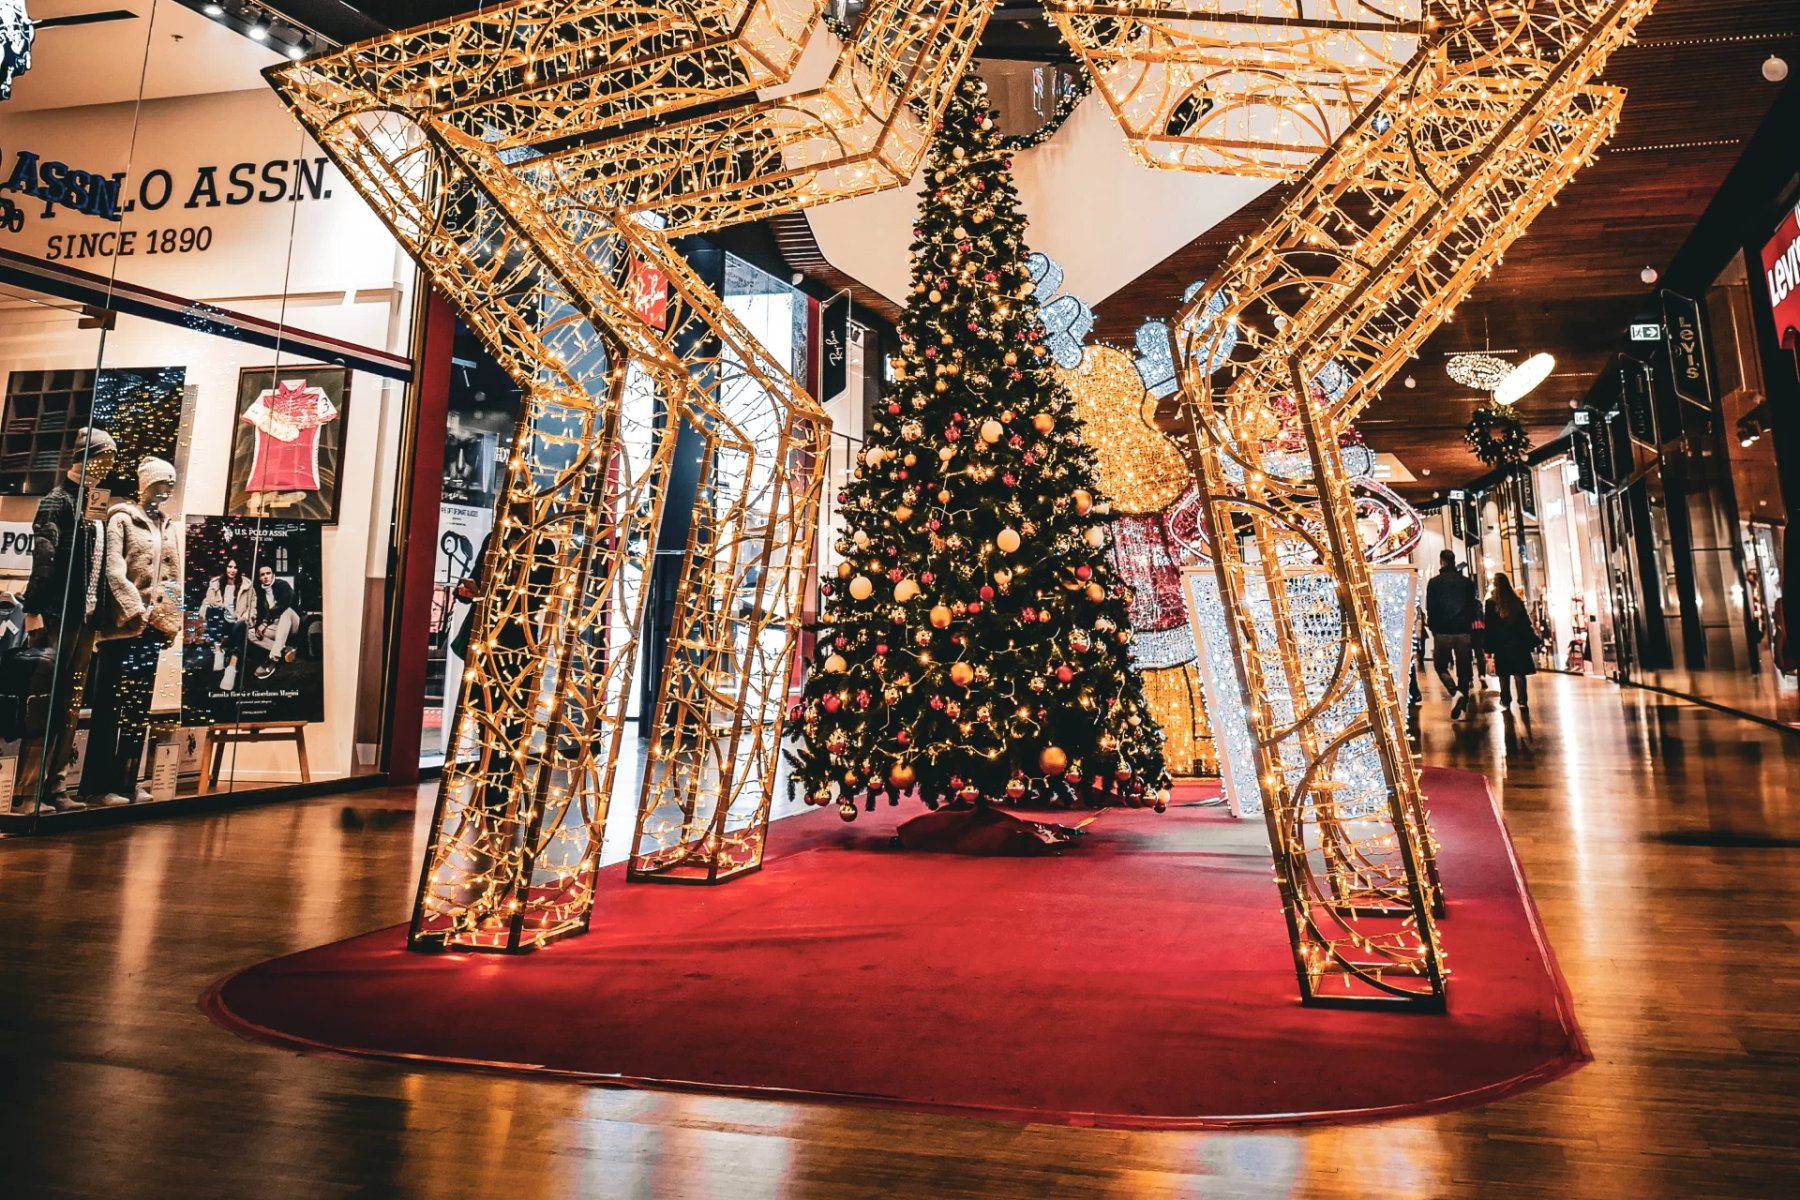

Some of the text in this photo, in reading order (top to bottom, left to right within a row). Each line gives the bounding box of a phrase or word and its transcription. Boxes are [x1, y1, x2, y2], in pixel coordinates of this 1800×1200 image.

[184, 157, 332, 208] ASSN.
[46, 226, 213, 260] SINCE 1890
